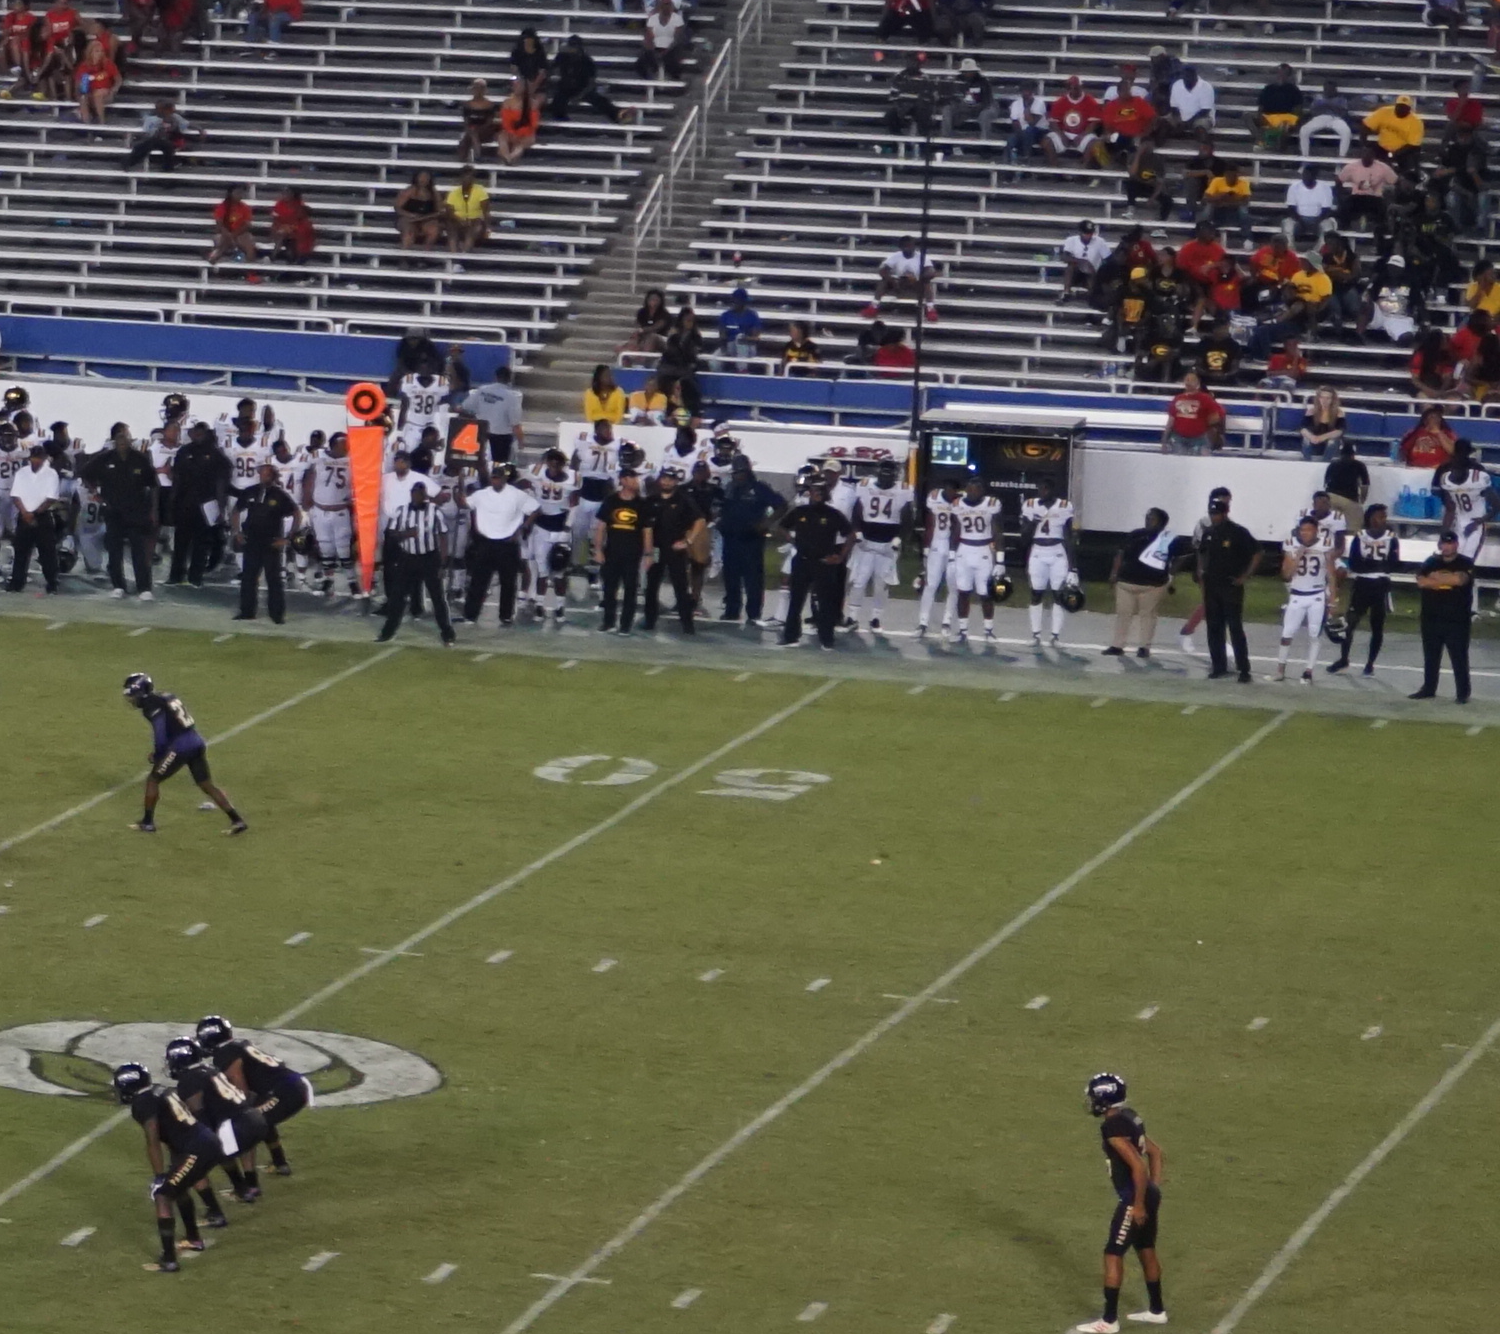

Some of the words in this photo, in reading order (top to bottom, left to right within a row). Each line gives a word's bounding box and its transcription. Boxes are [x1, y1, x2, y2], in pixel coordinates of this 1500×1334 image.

[414, 394, 434, 416] 38
[452, 420, 480, 456] 4
[870, 496, 894, 520] 94
[963, 516, 988, 533] 20
